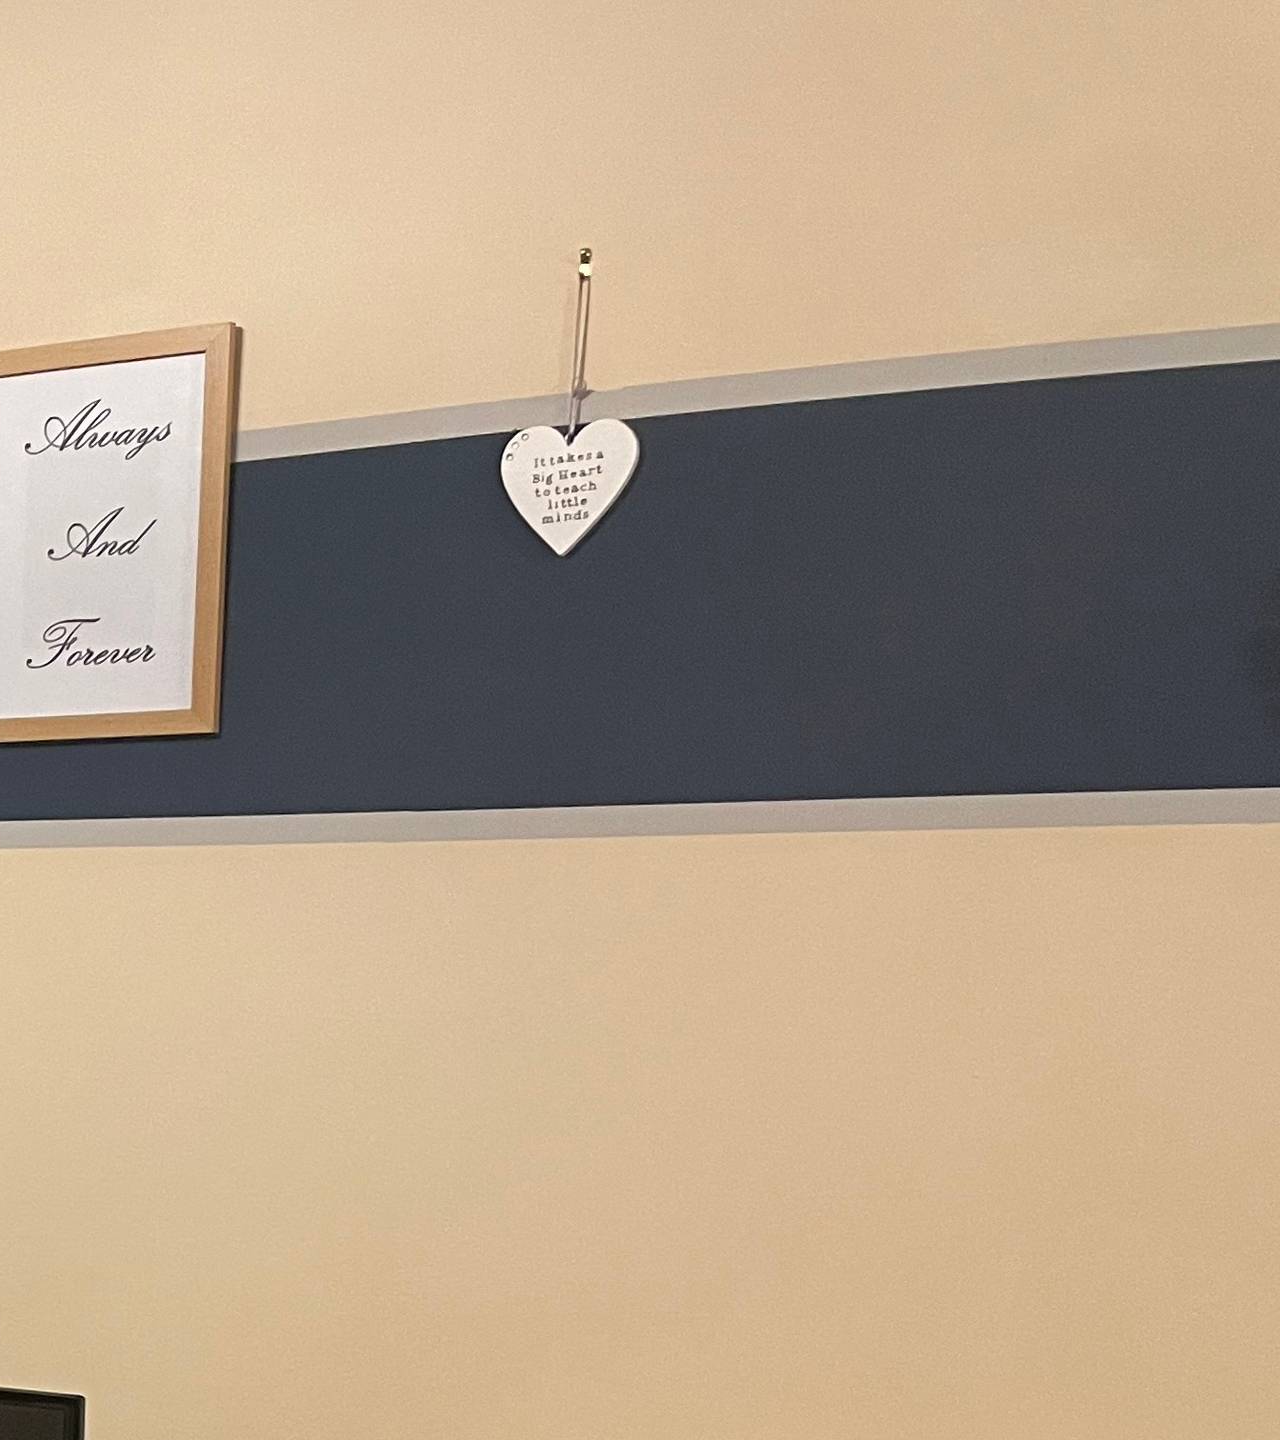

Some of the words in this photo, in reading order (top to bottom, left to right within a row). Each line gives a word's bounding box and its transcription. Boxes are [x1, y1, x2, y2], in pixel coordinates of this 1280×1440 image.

[24, 398, 172, 461] Always
[534, 457, 546, 468] It
[550, 451, 593, 466] takes
[596, 451, 604, 459] a
[532, 473, 554, 486] Big
[558, 465, 602, 480] Heart
[535, 488, 551, 498] to
[555, 481, 597, 495] teach
[547, 497, 588, 510] little
[542, 510, 589, 525] minds
[47, 506, 158, 561] And
[26, 616, 156, 670] Forever
